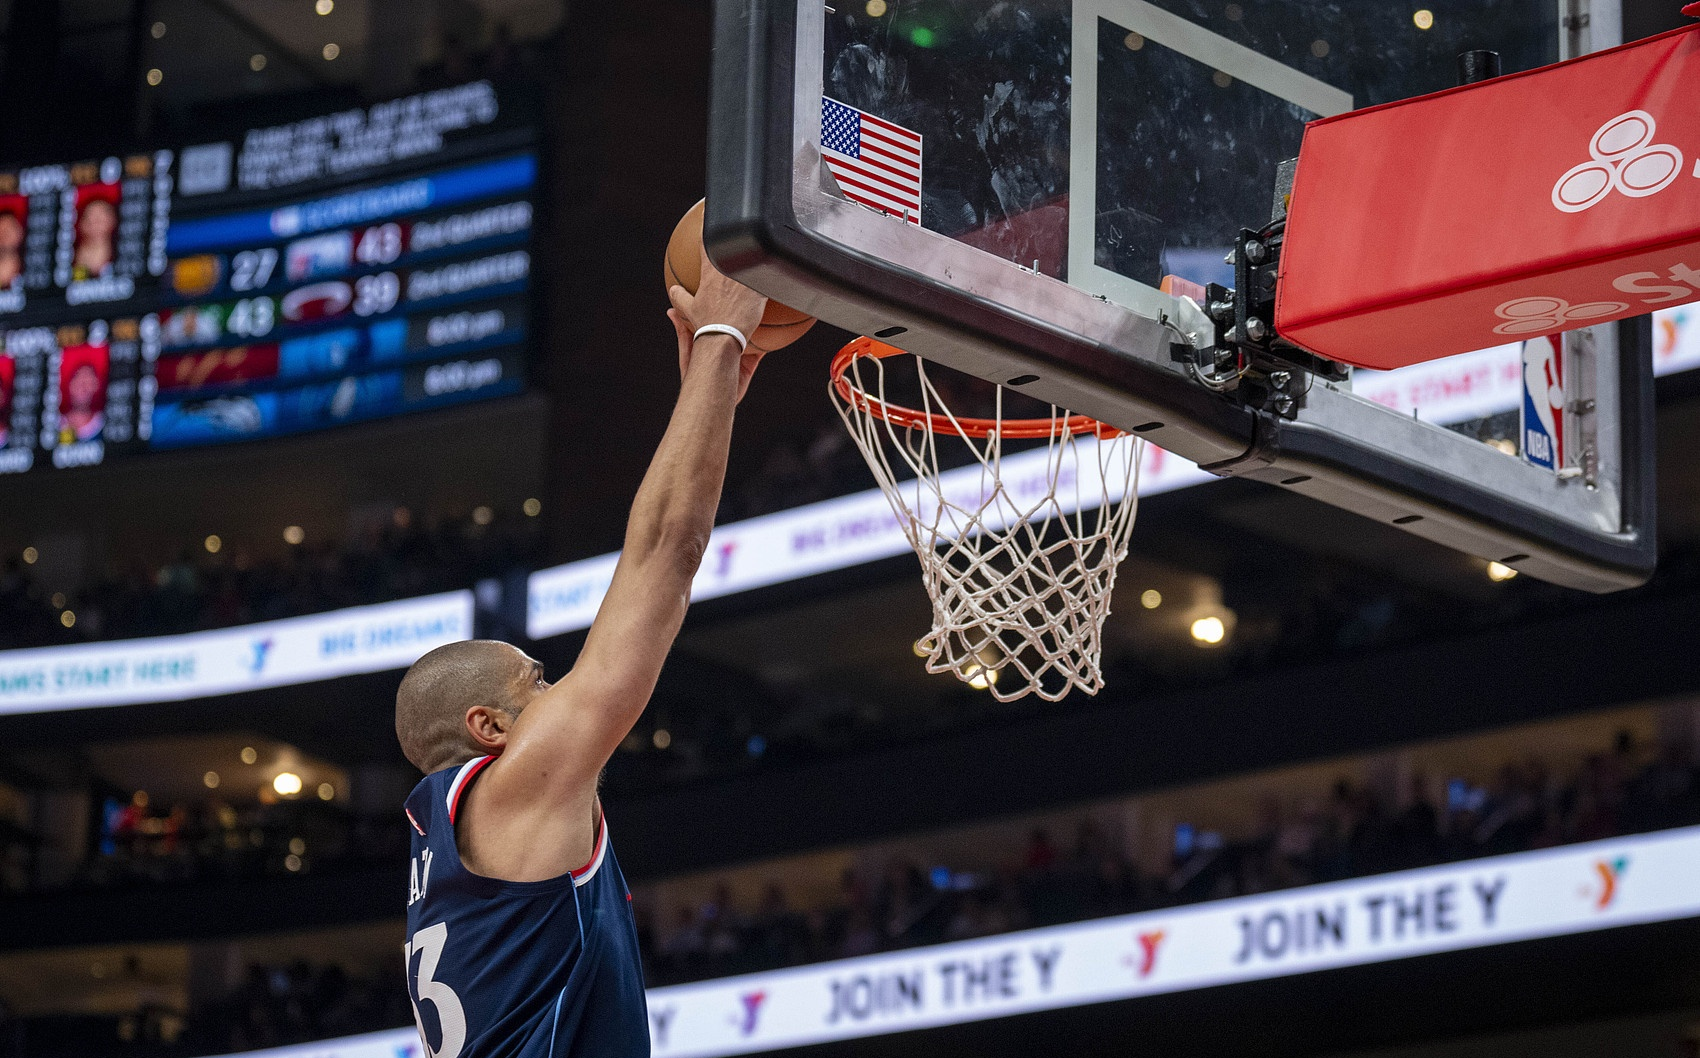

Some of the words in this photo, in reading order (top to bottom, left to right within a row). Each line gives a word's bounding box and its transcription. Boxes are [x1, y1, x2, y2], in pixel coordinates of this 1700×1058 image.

[356, 222, 401, 266] 43
[231, 249, 278, 291] 27
[353, 271, 399, 316] 39
[227, 297, 275, 337] 43
[1527, 429, 1551, 462] NBA
[53, 660, 126, 690] START
[134, 654, 197, 684] HERE
[1234, 899, 1346, 964] JOIN
[1363, 881, 1459, 942] THE
[1473, 873, 1506, 924] Y
[405, 922, 466, 1058] 3
[826, 967, 926, 1025] JOIN
[939, 952, 1020, 1000] THE
[1032, 946, 1064, 992] Y
